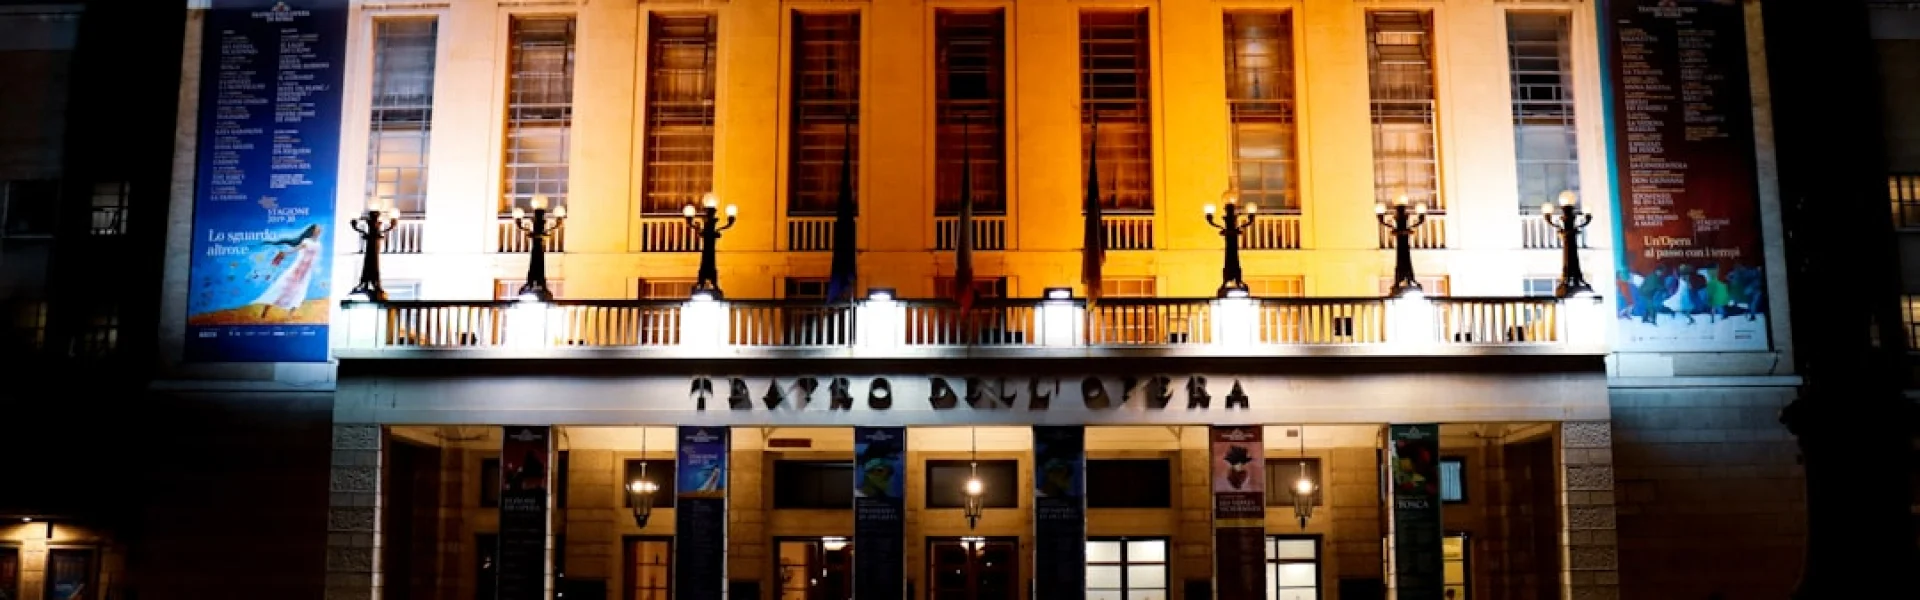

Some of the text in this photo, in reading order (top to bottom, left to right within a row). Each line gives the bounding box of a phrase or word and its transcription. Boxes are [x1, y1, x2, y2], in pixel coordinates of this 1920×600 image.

[267, 207, 310, 216] STAGIONE
[208, 229, 277, 244] Lo sguardo
[1643, 235, 1692, 247] Un'Opera
[207, 244, 250, 257] altrove
[1643, 247, 1654, 258] al
[1656, 249, 1684, 259] passo
[1685, 249, 1704, 257] con
[1711, 247, 1740, 259] tempi
[690, 375, 892, 411] TEATRO
